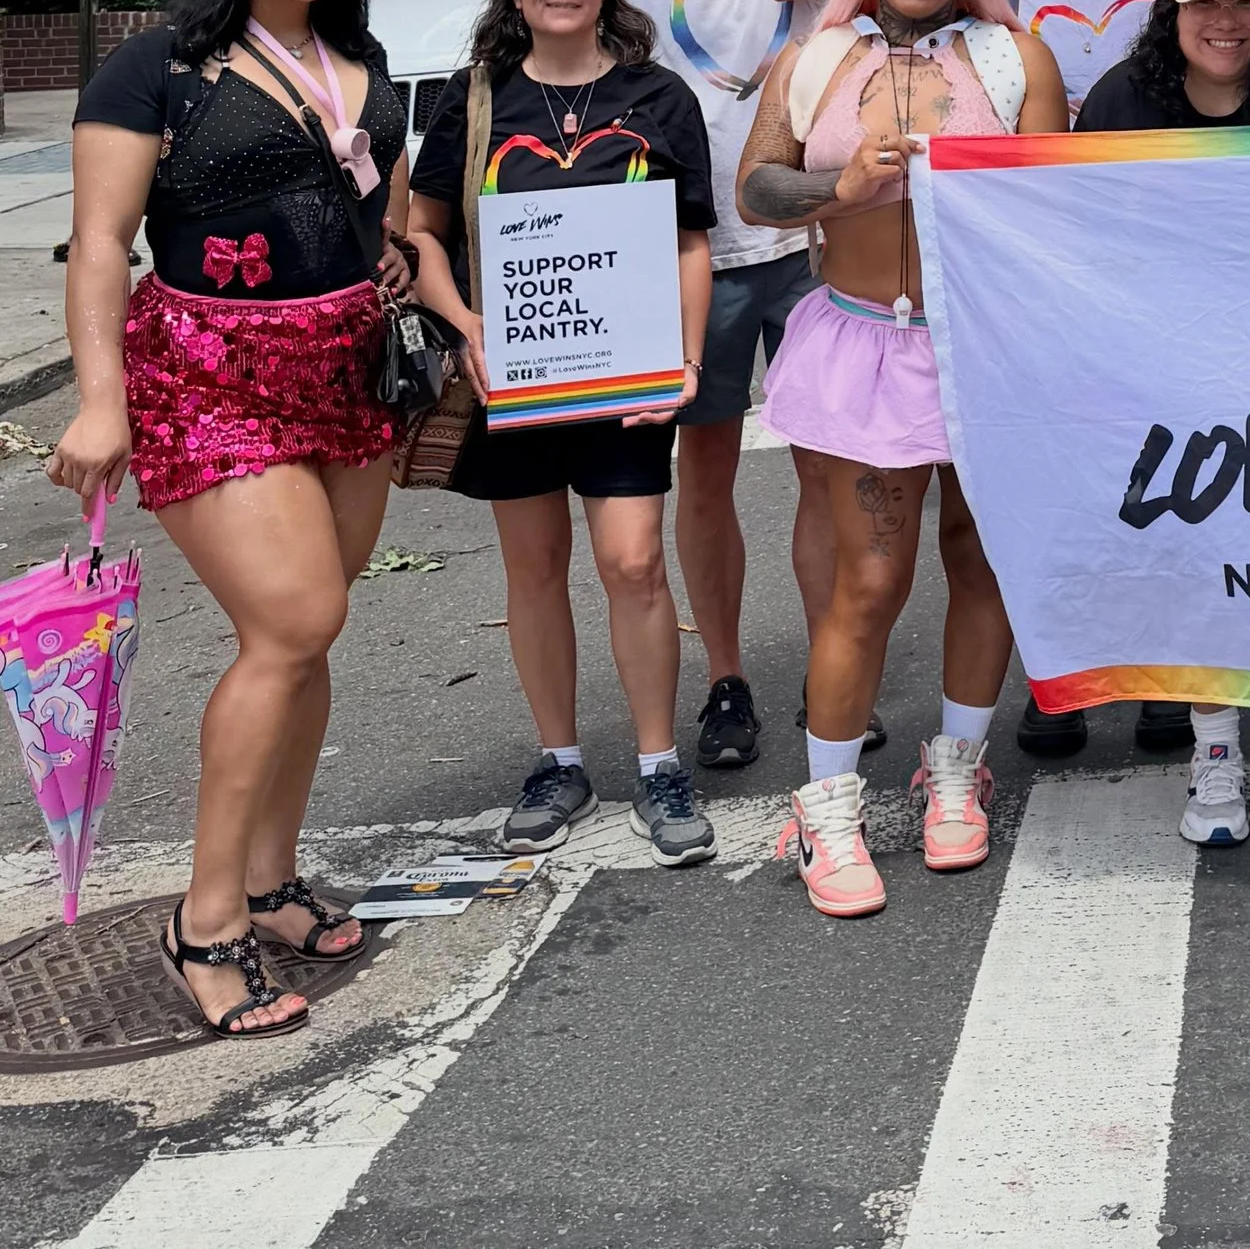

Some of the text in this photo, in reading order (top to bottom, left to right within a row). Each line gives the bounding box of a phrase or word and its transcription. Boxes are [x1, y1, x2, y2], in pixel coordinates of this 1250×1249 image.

[499, 219, 528, 235] LOVE
[503, 251, 618, 278] SUPPORT
[503, 277, 573, 300] YOUR
[505, 298, 589, 322] LOCAL
[506, 318, 609, 344] PANTRY.
[505, 350, 613, 368] WWW.LOVEWINSNYC.ORG
